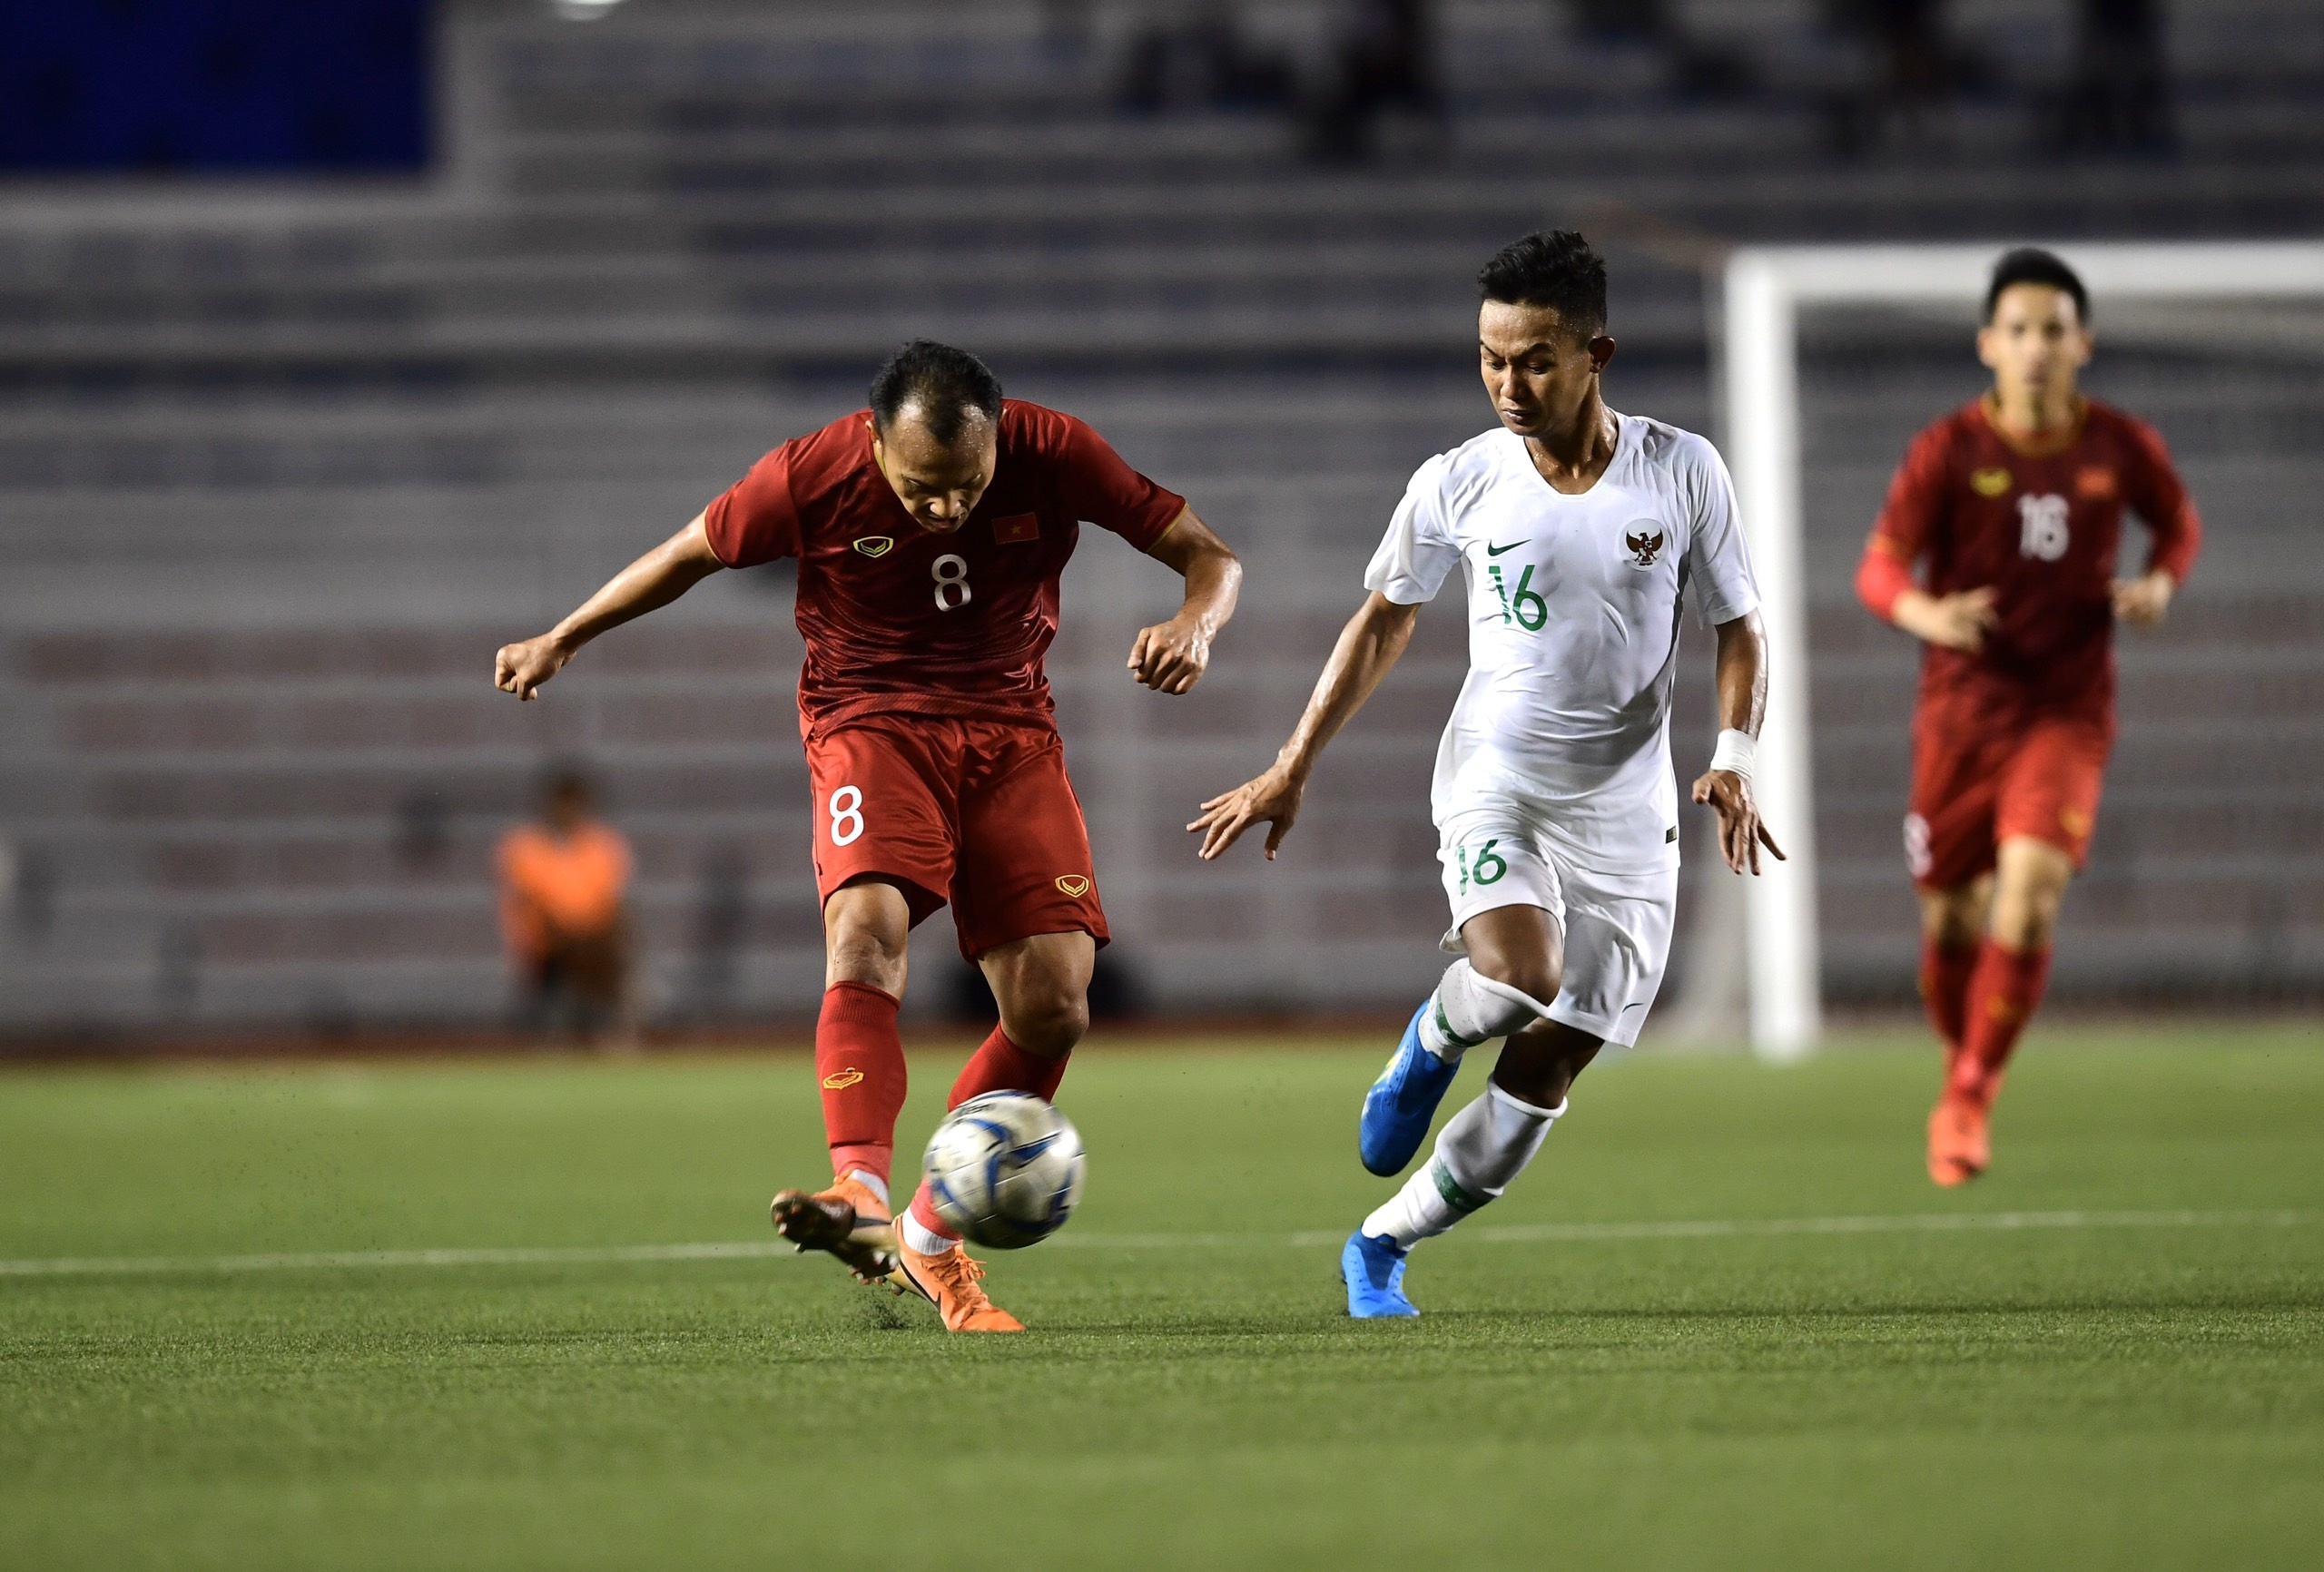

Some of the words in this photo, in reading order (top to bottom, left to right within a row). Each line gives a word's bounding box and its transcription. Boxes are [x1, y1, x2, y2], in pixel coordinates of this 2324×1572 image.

[931, 554, 971, 612] 8
[1488, 564, 1548, 632] 16
[829, 784, 865, 848] 8
[1457, 839, 1507, 897] 16
